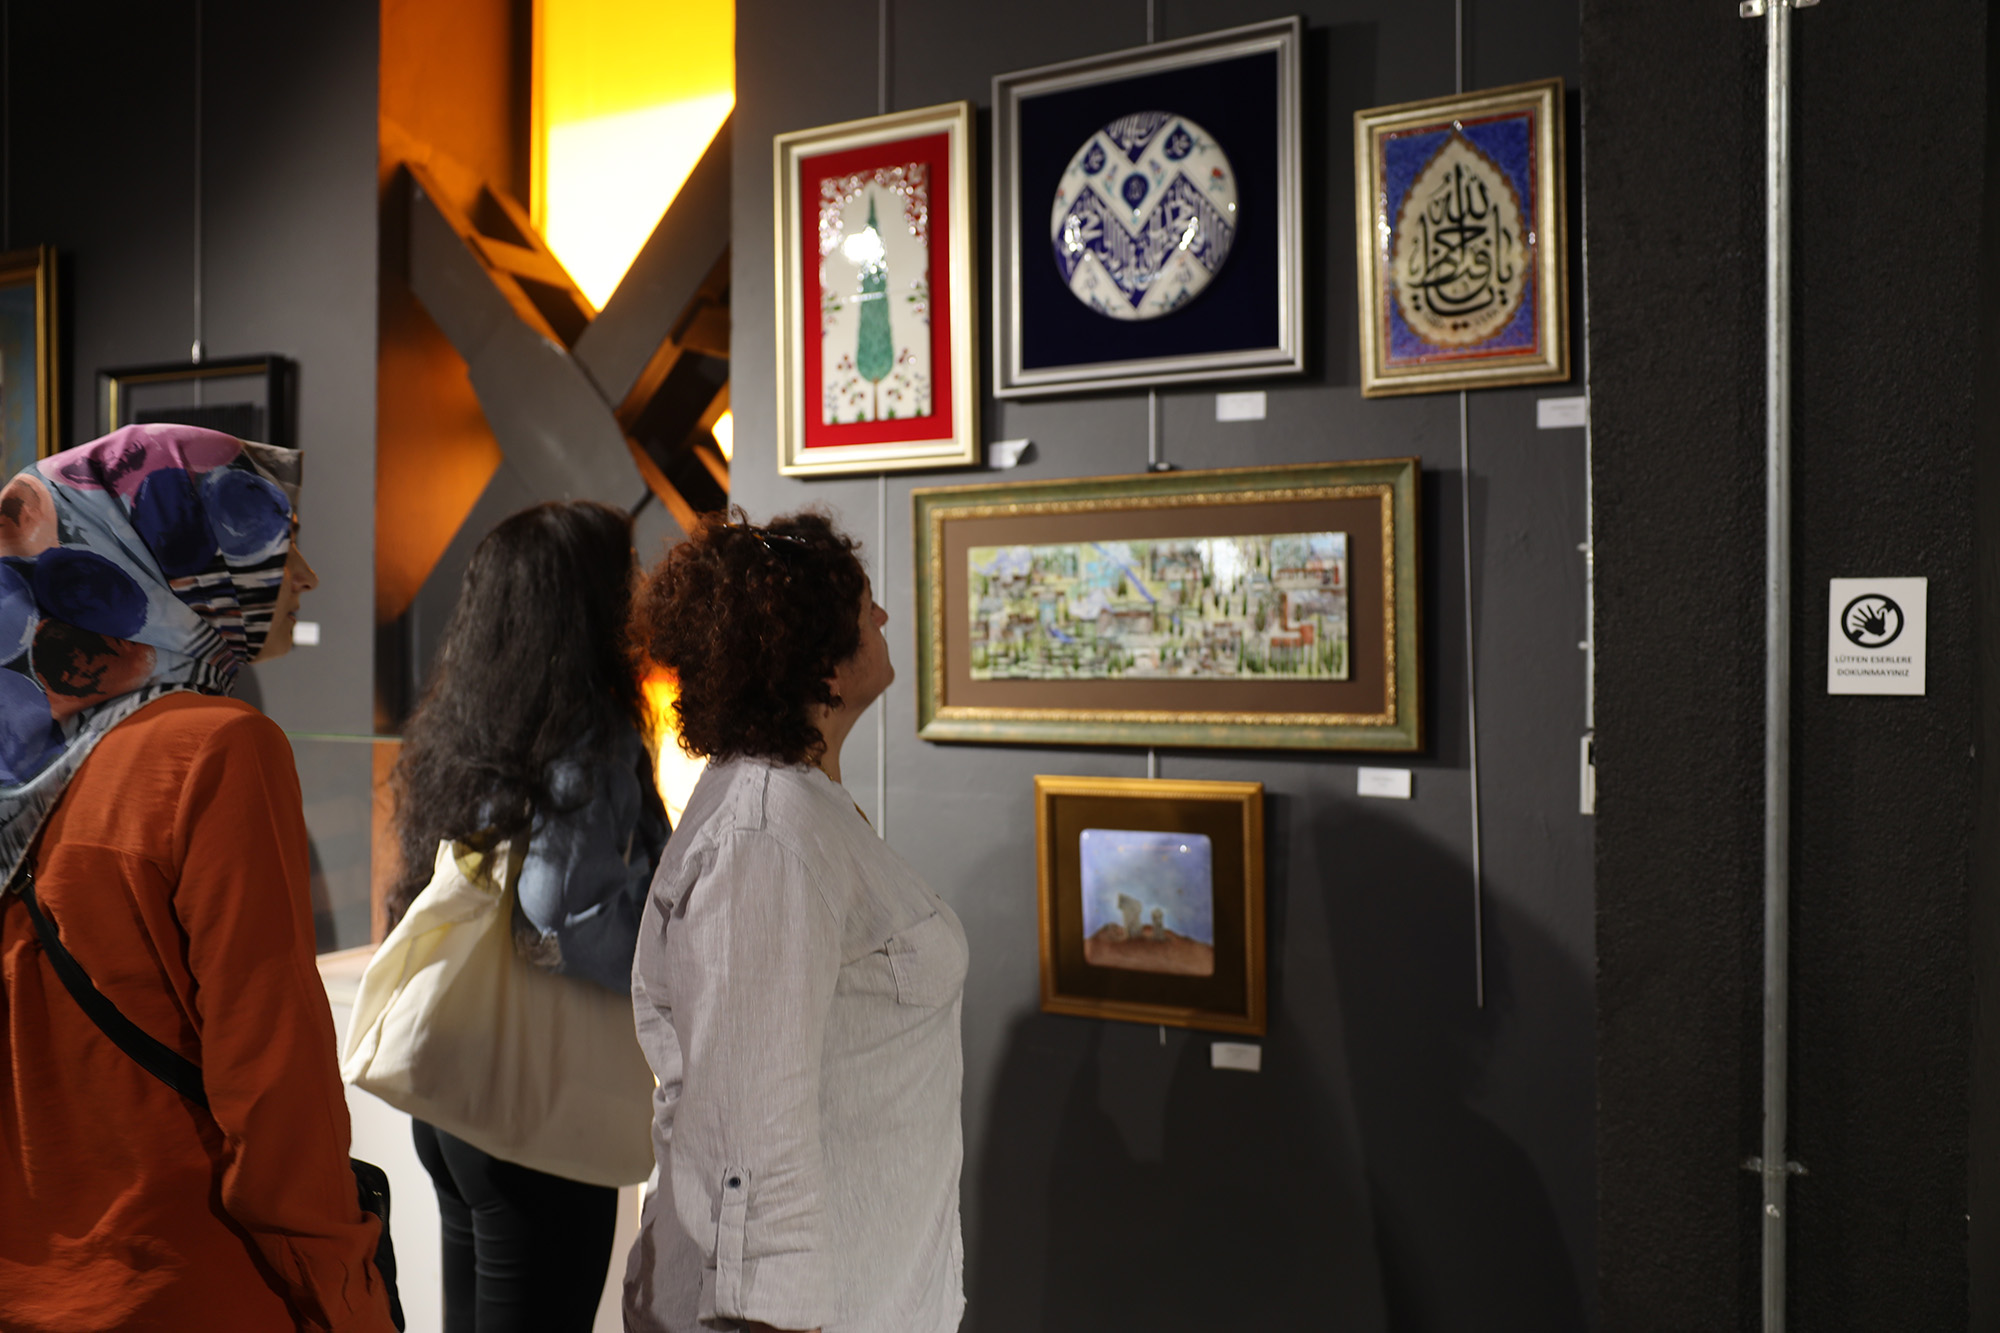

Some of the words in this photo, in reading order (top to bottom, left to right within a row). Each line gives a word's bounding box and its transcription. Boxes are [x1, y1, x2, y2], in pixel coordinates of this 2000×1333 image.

[1835, 654, 1868, 663] LÜTFEN
[1870, 655, 1911, 664] ESERLERE
[1836, 668, 1910, 677] DOKUNMAYINIZ
